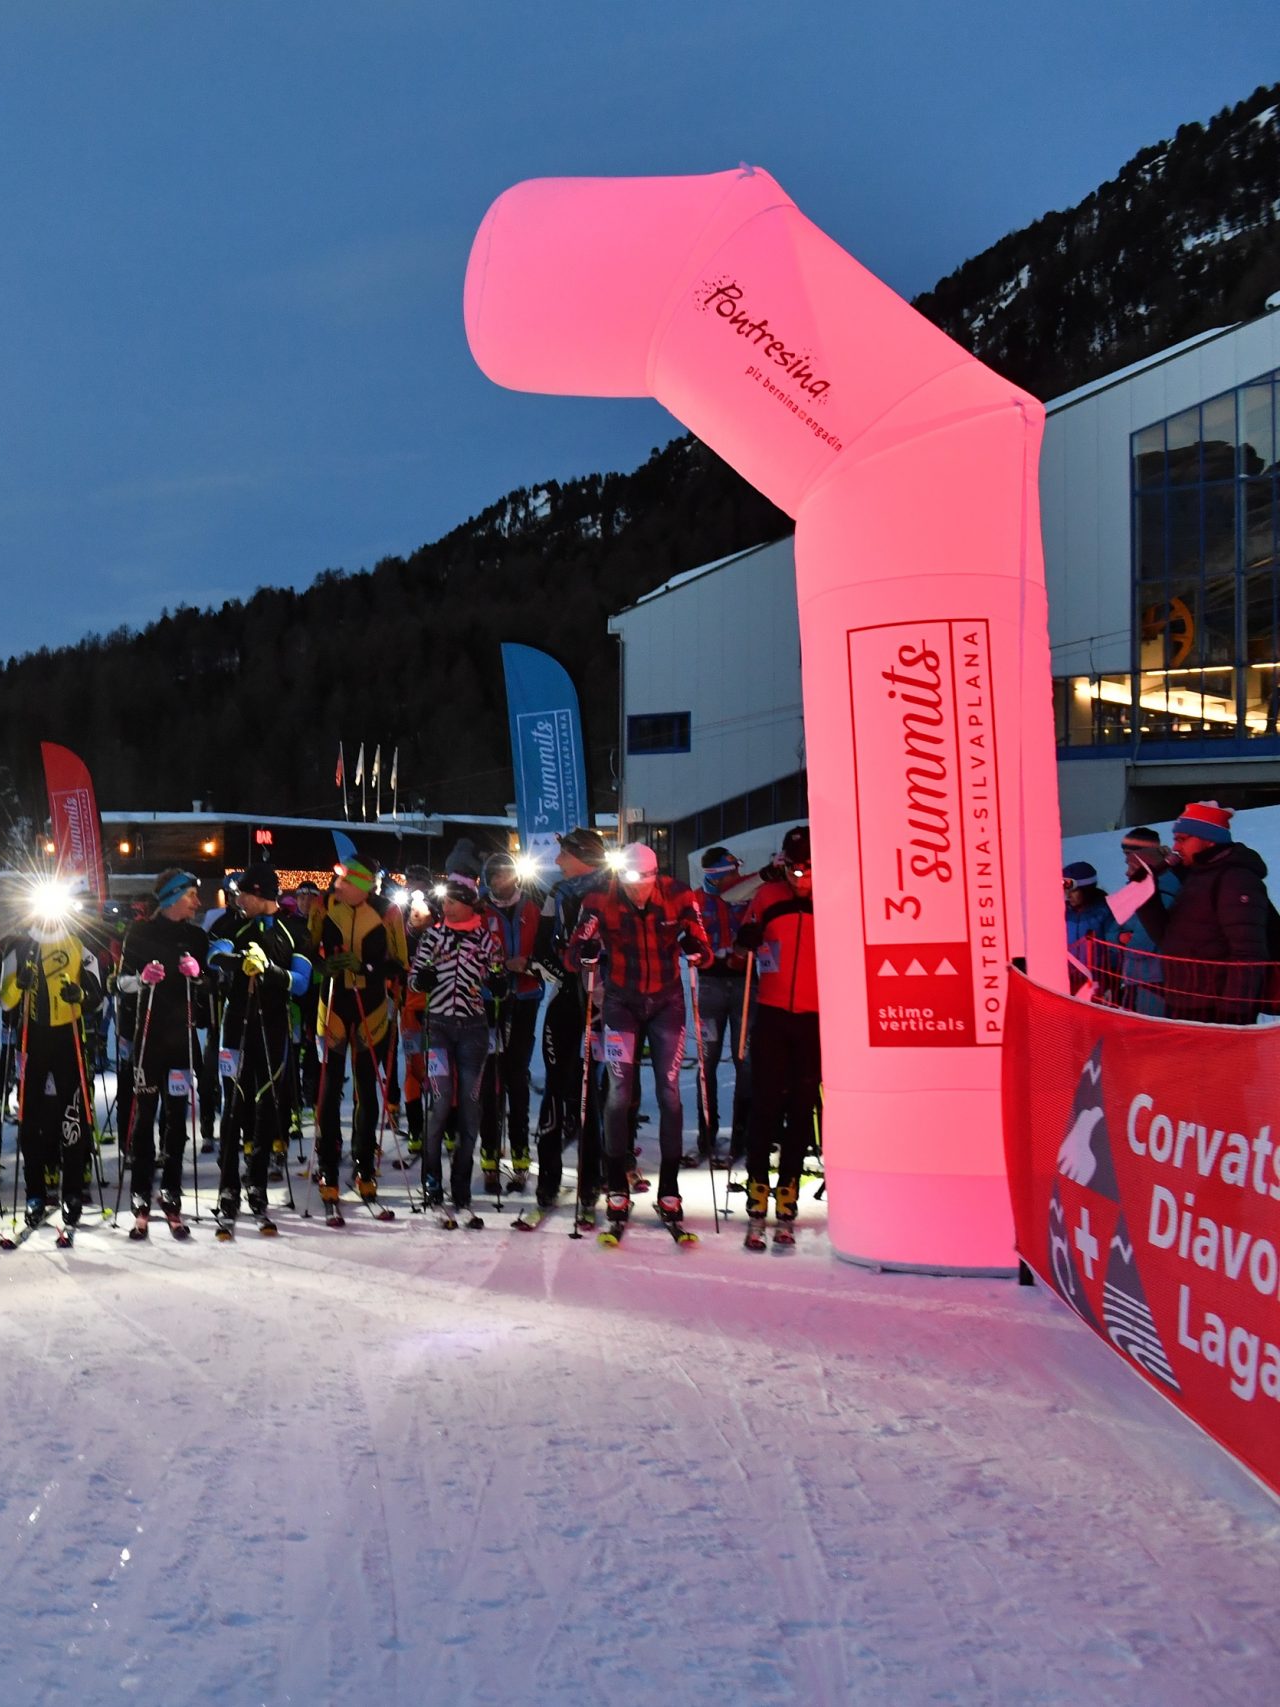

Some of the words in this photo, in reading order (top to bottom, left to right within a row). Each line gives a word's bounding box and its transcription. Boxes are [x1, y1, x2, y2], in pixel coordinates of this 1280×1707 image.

[704, 283, 831, 399] Pontresina
[745, 363, 763, 382] piz
[762, 377, 800, 414] bernina
[805, 416, 842, 452] engadin
[256, 829, 273, 845] BAR
[963, 631, 1001, 1033] PONTRESINA-SILVAPLANA
[878, 1005, 934, 1019] skimo
[879, 1017, 966, 1032] verticals
[1147, 1183, 1280, 1301] Diavo
